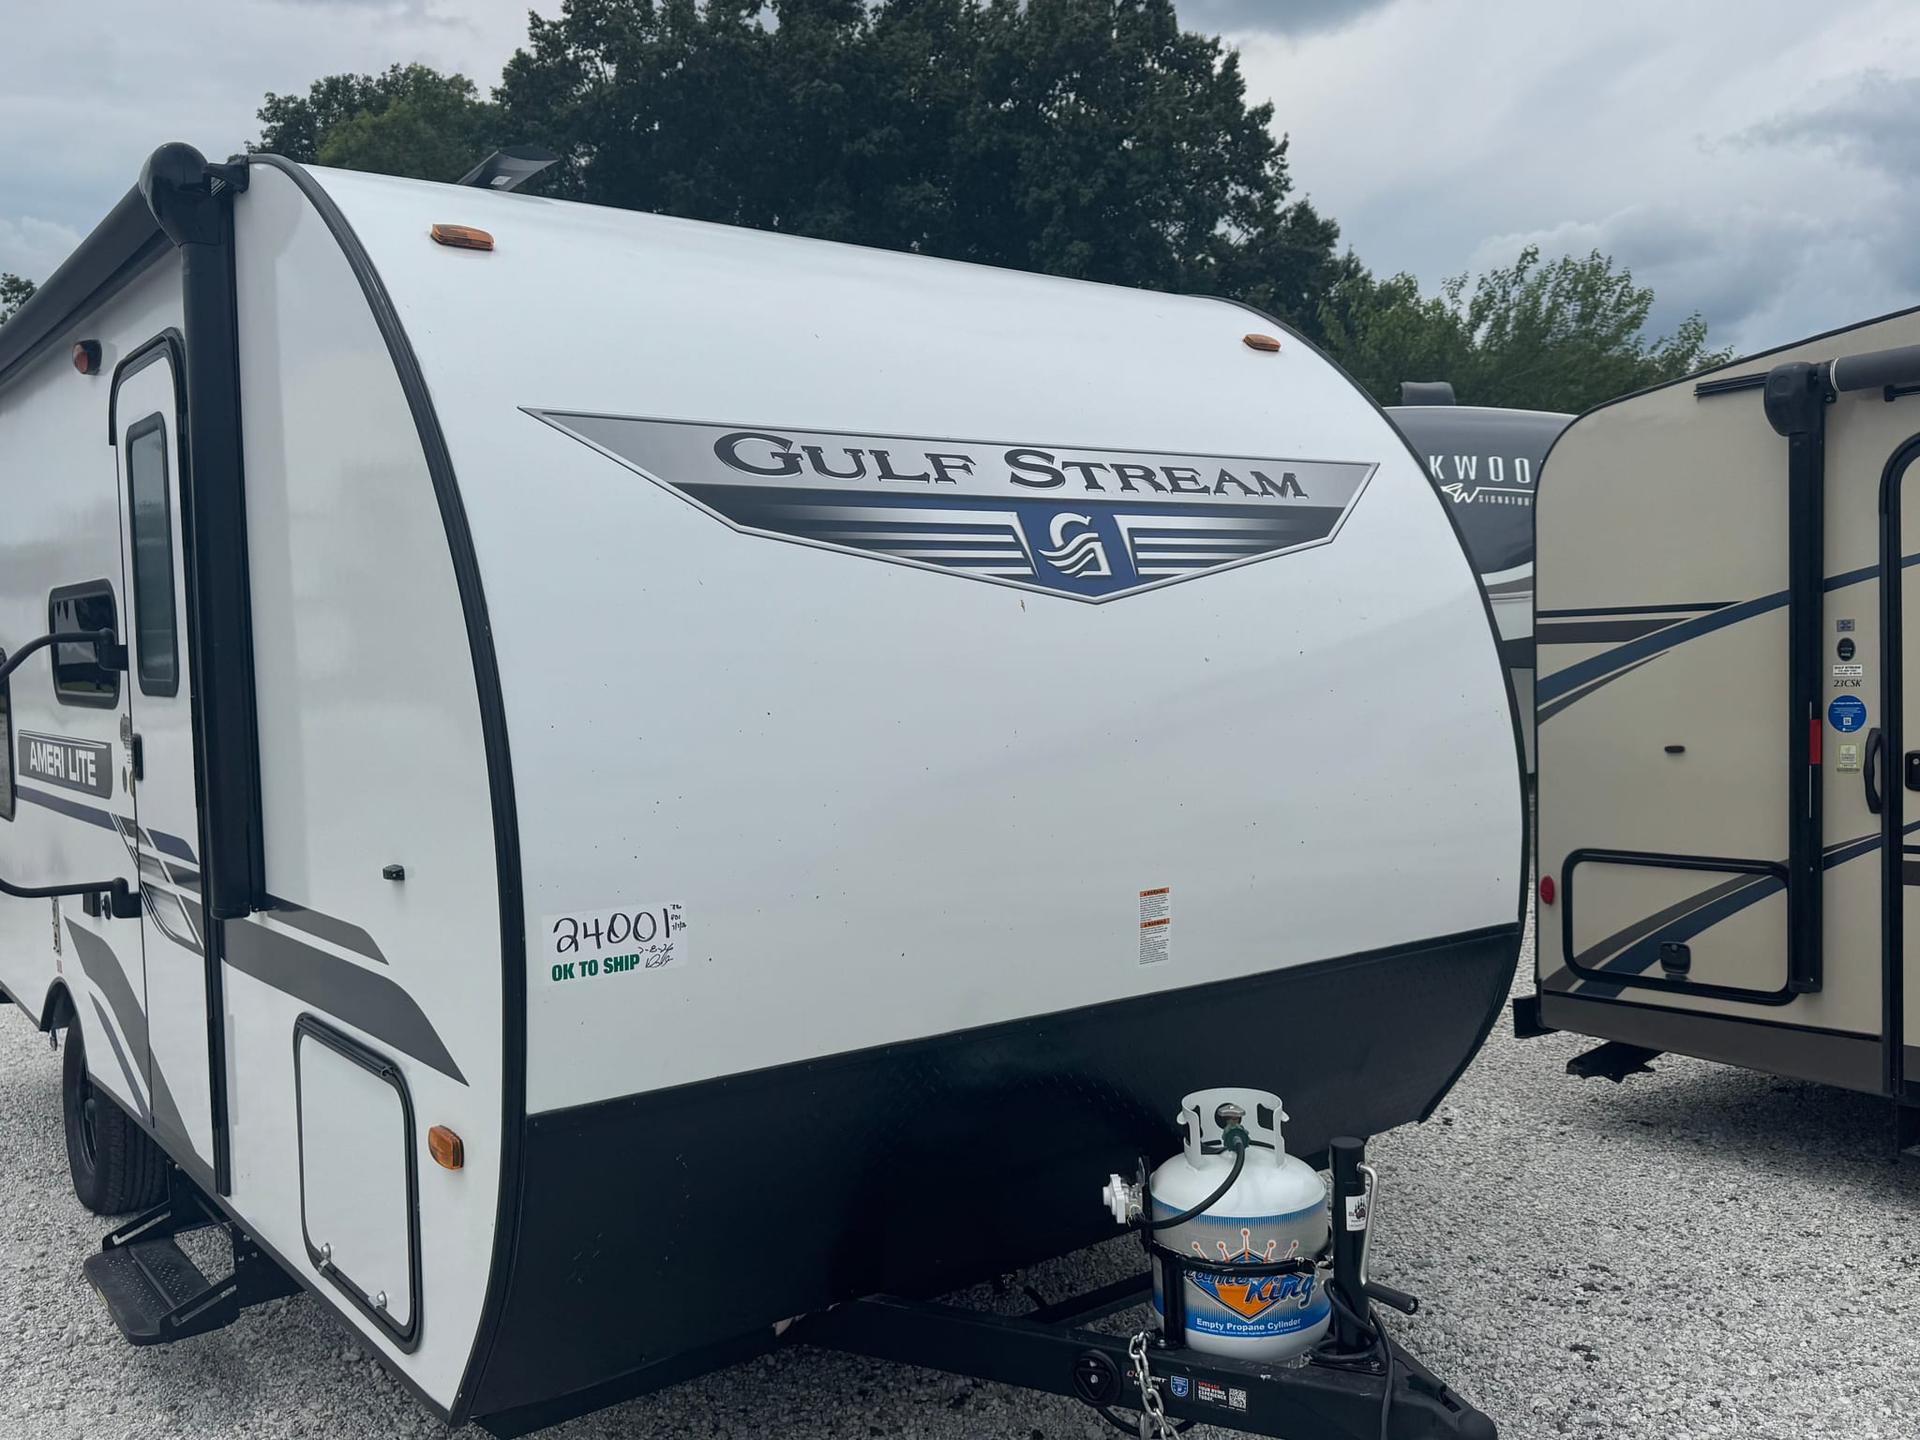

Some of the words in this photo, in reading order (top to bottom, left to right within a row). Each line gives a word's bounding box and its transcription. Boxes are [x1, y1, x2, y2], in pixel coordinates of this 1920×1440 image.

[713, 431, 977, 485] GULF
[1003, 448, 1310, 500] STREAM
[1428, 455, 1543, 484] KWOO
[1833, 678, 1862, 688] 23CSK
[29, 741, 65, 779] AMERI
[68, 747, 97, 787] LITE
[553, 907, 670, 953] 24001
[551, 962, 575, 982] OK
[579, 959, 599, 978] TO
[603, 953, 640, 975] SHIP
[1244, 1272, 1317, 1310] King
[1196, 1317, 1225, 1331] Empty
[1226, 1322, 1265, 1333] Propane
[1267, 1317, 1302, 1331] Cylinder
